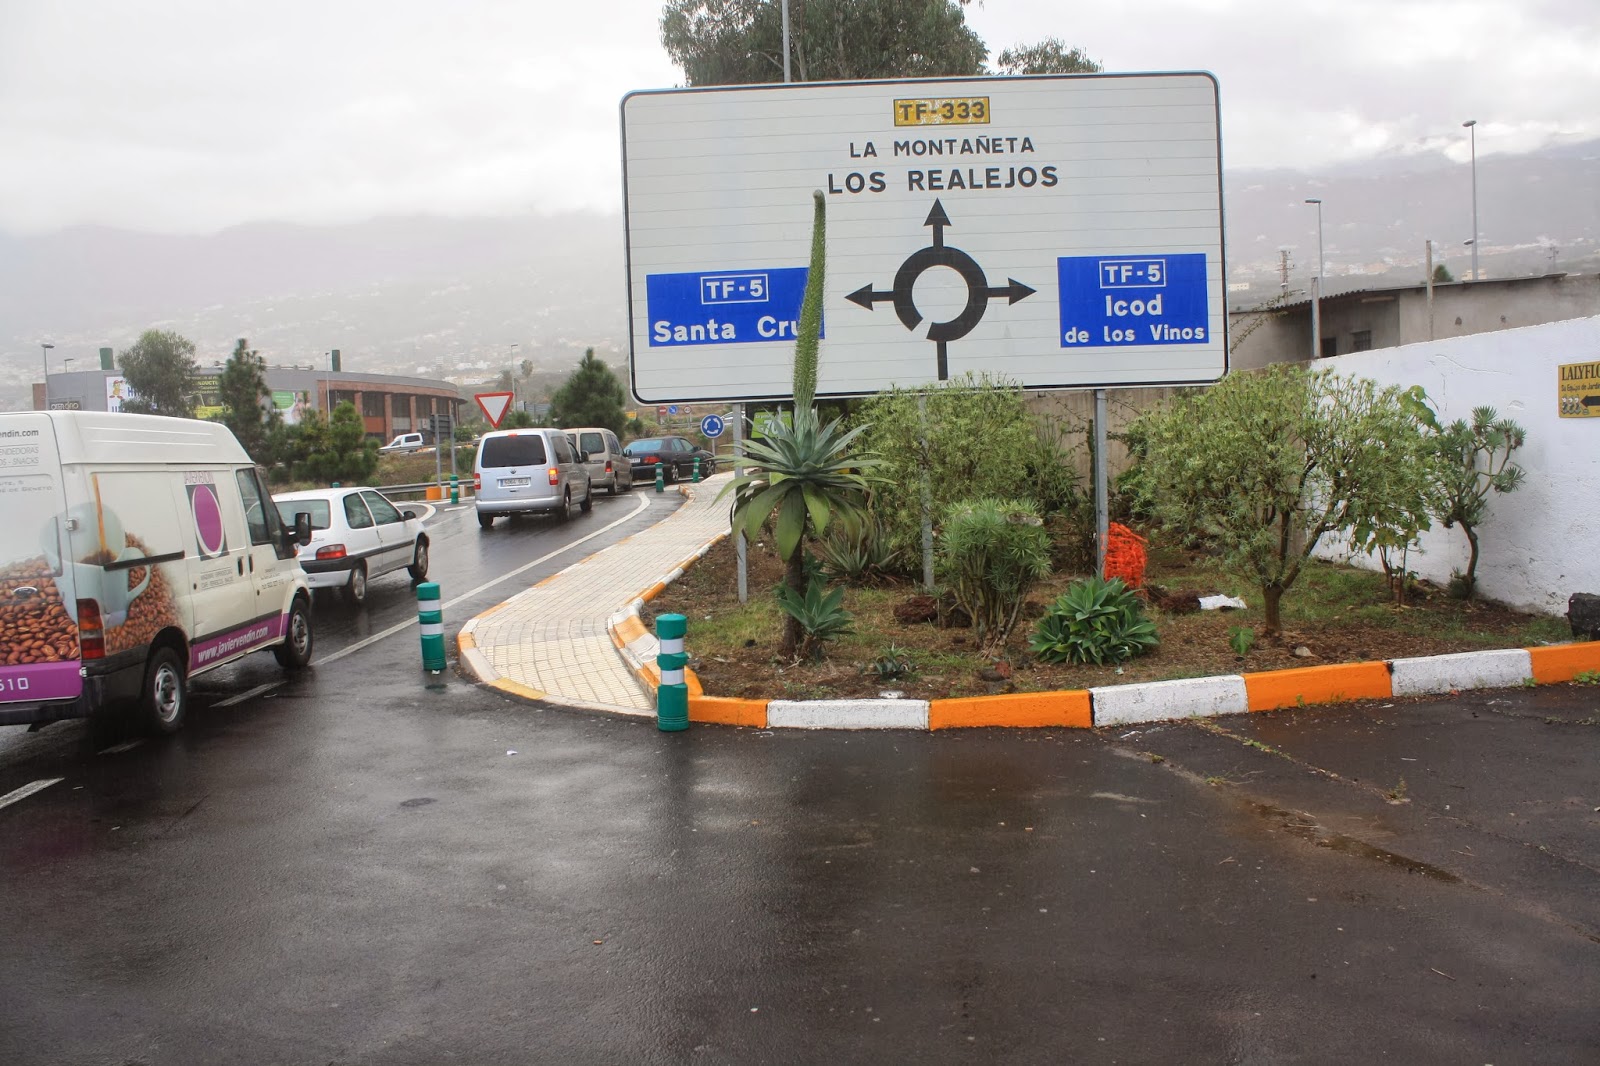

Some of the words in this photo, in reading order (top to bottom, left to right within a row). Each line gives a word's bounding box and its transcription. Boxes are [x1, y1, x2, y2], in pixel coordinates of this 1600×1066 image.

[898, 102, 985, 121] TF-333
[849, 142, 878, 158] LA
[893, 135, 1035, 157] MONTAÑETA
[828, 171, 887, 194] LOS
[908, 166, 1058, 191] REALEJOS
[1104, 264, 1161, 283] TF-5
[706, 279, 763, 299] TF-5
[1105, 293, 1162, 316] Icod
[653, 318, 736, 342] Santa
[757, 315, 801, 338] Cru
[1065, 326, 1090, 343] de
[1103, 325, 1136, 342] los
[1150, 324, 1205, 341] Vinos
[198, 626, 269, 663] www.javiervendin.com
